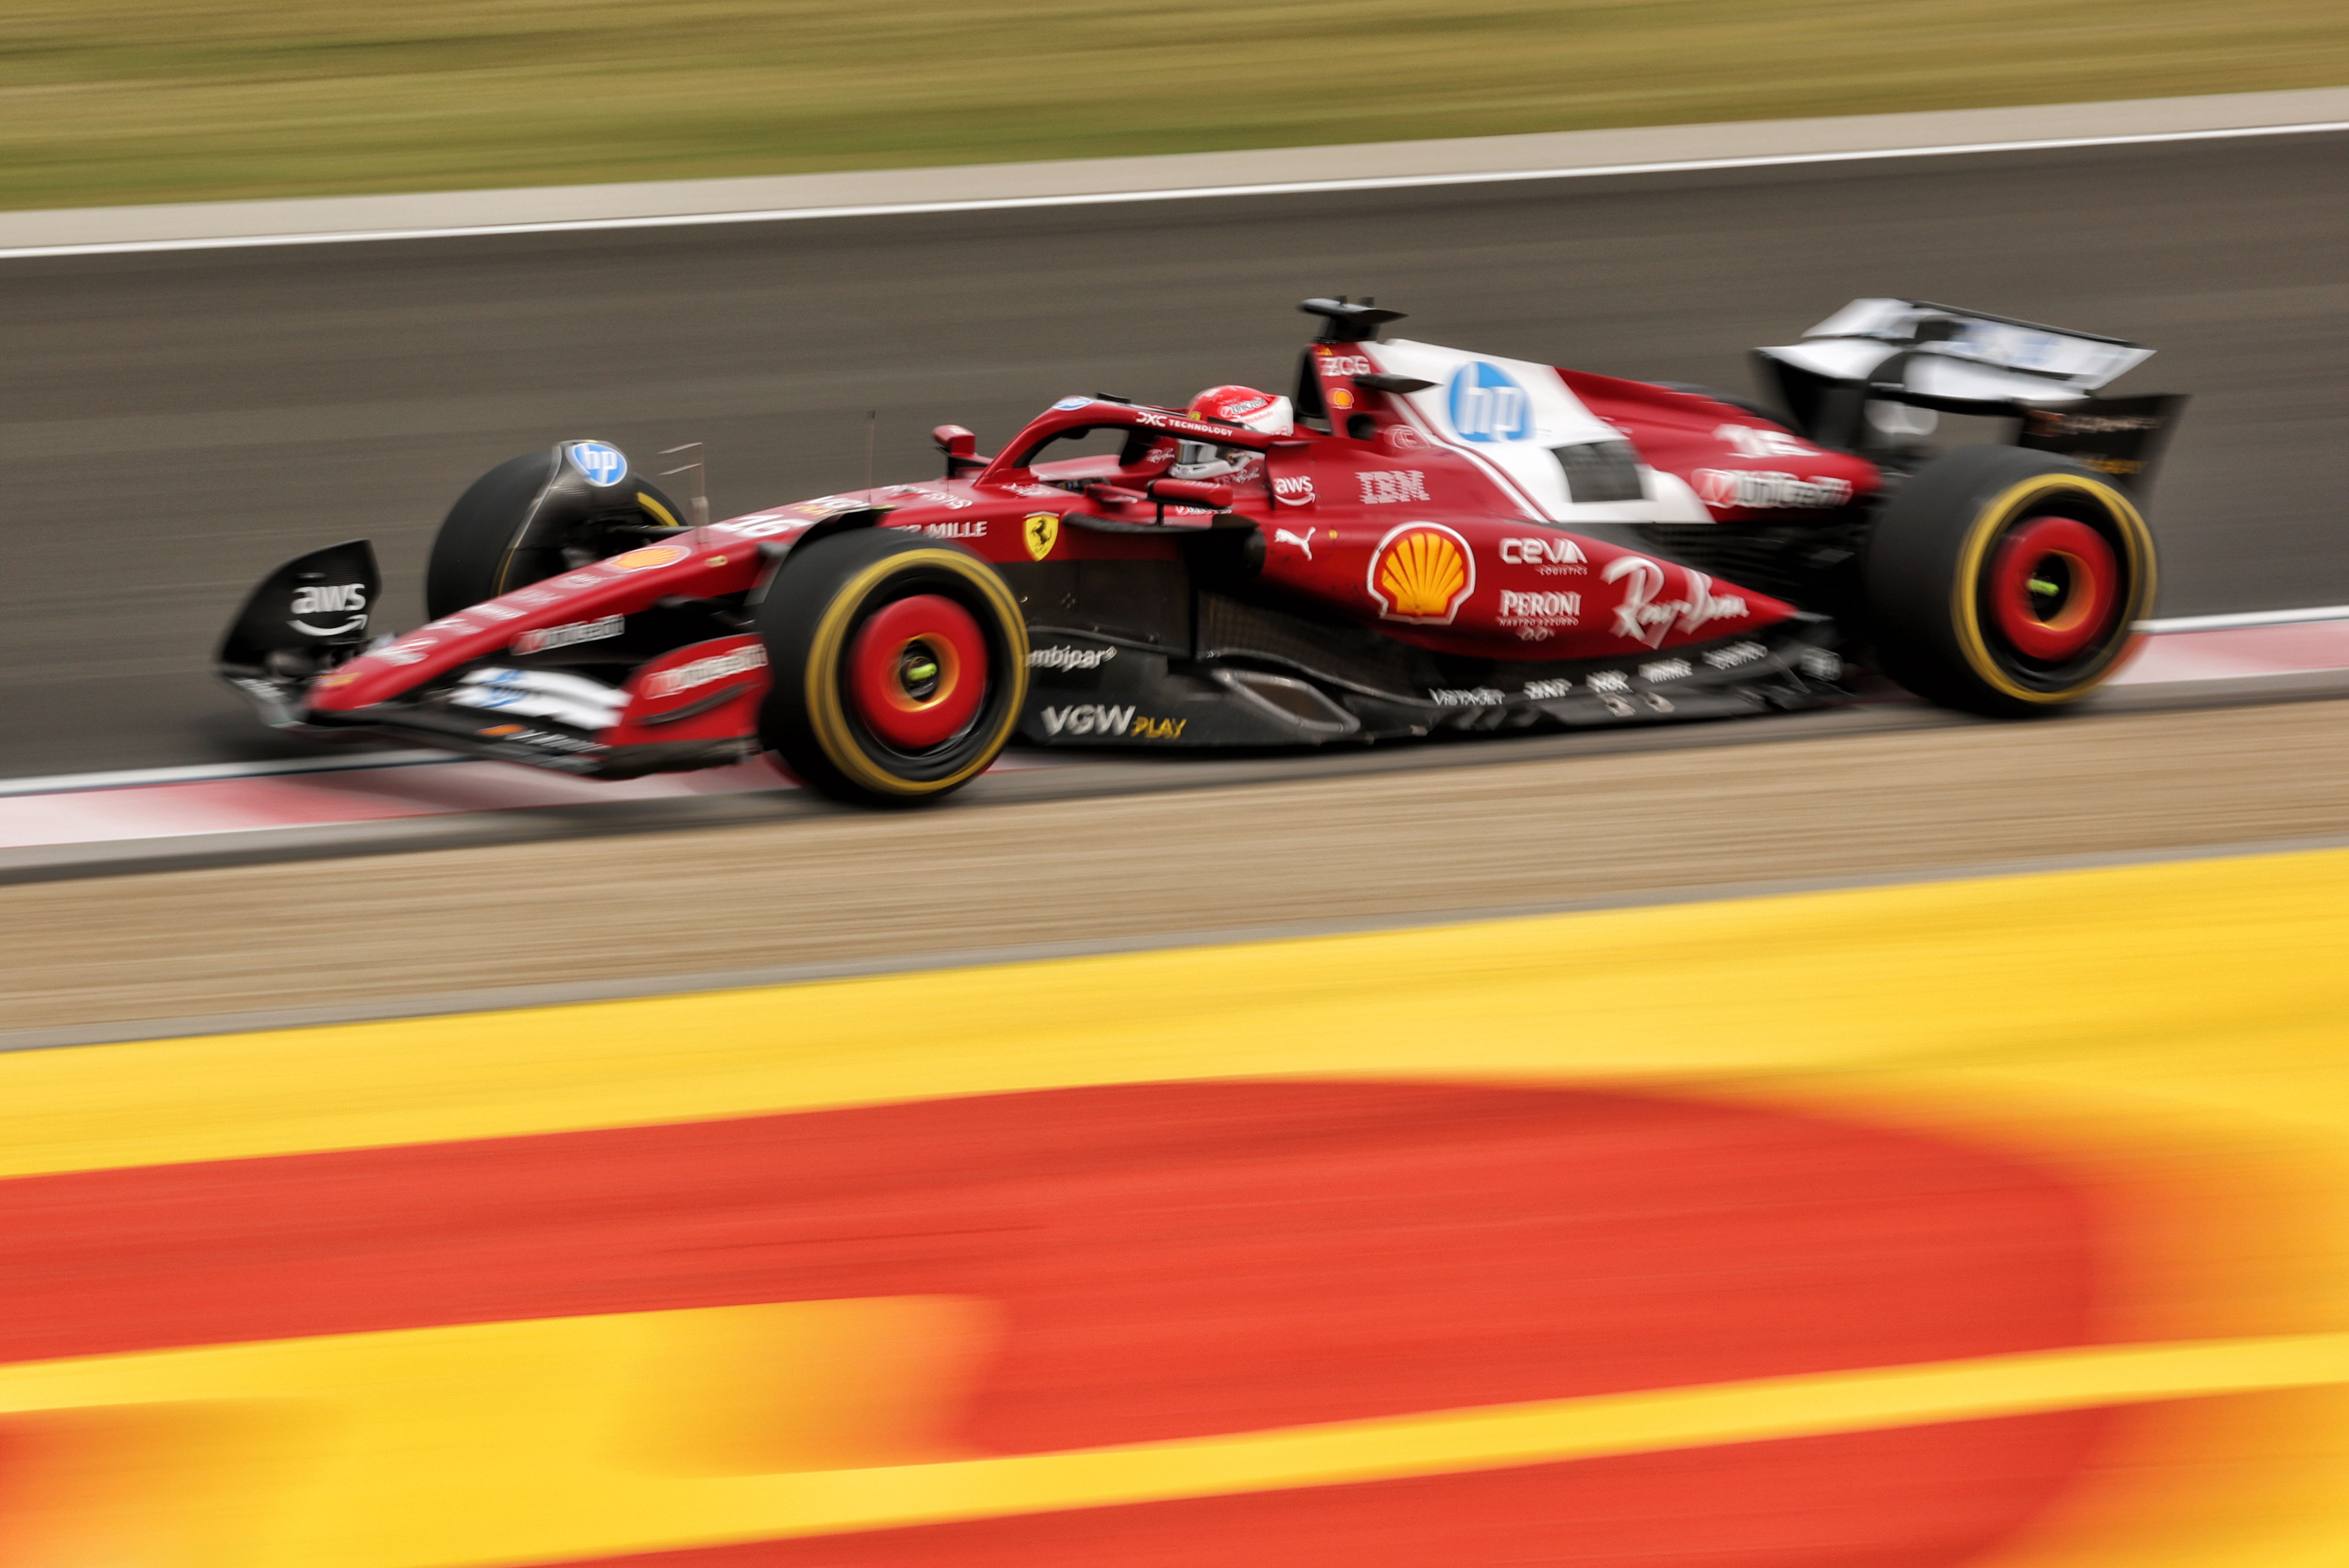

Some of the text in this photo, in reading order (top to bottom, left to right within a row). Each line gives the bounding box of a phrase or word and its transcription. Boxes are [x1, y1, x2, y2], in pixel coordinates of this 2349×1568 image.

[1457, 361, 1523, 443] hp
[1136, 411, 1234, 436] DXC TECHNOLOGY
[580, 444, 619, 487] hp
[1274, 476, 1313, 494] aws
[1355, 470, 1430, 505] IBM
[923, 521, 988, 539] MILLE
[1535, 564, 1587, 576] LOGISTICS
[291, 584, 365, 613] aws
[1498, 589, 1582, 617] PERONI
[1496, 616, 1579, 627] NASTRO AZZURRO
[1041, 704, 1187, 739] VGW PLAY
